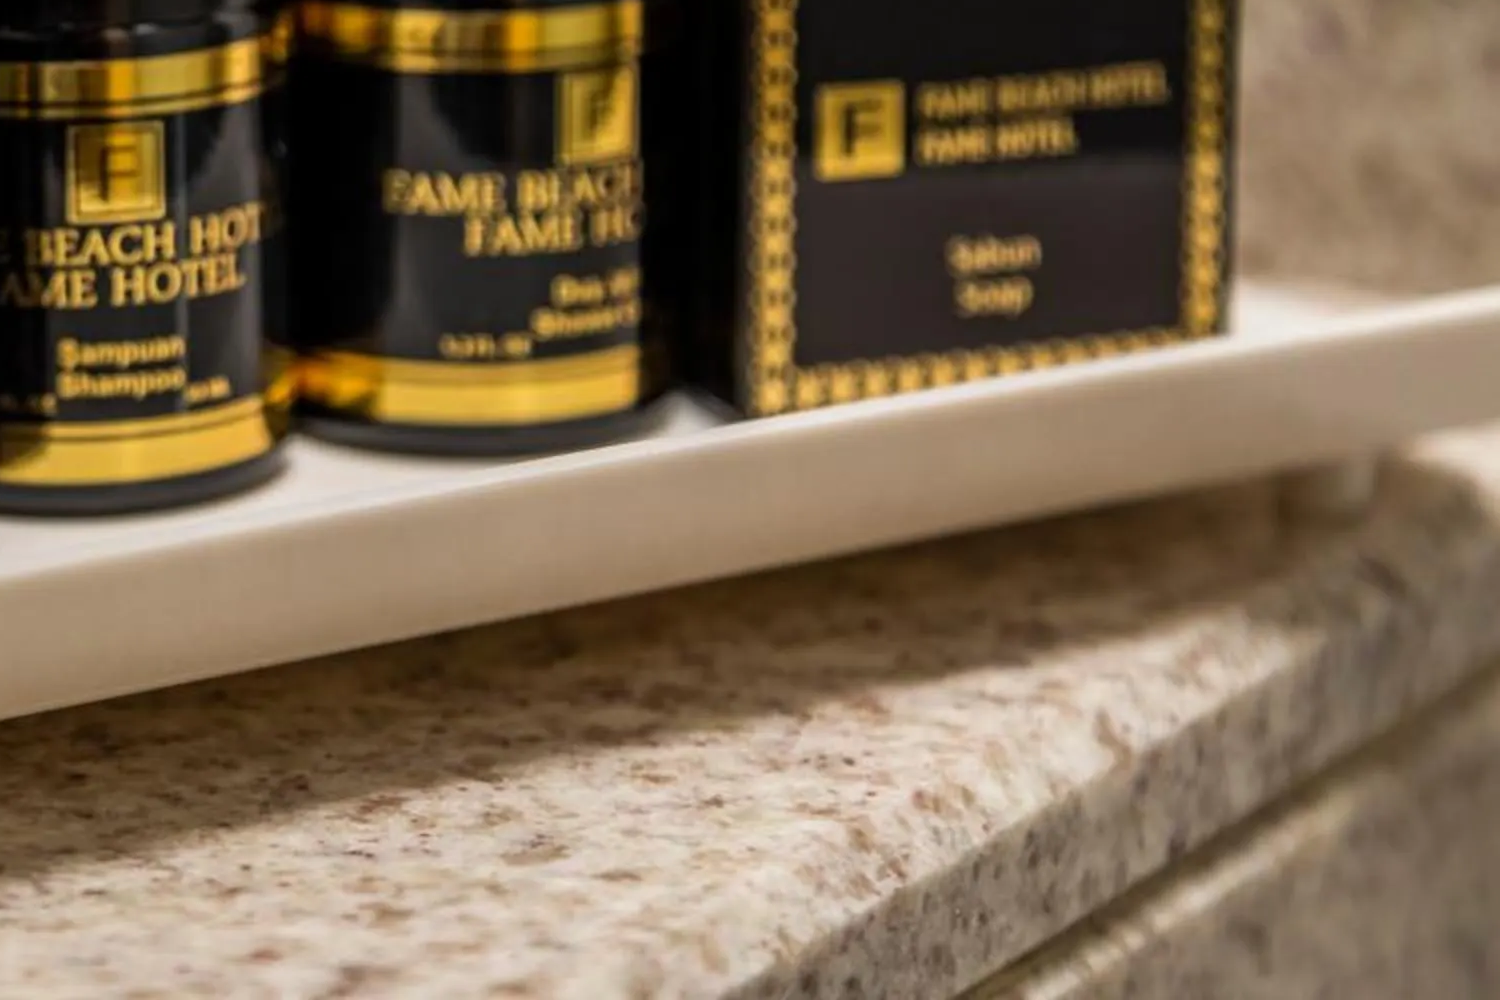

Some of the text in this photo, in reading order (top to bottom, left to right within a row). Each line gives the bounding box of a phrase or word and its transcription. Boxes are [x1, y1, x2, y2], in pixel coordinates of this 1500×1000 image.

[384, 169, 504, 214] FAME
[25, 221, 176, 266] BEACH
[188, 203, 264, 254] HOT
[464, 210, 581, 257] FAME
[2, 252, 246, 308] AME HOTEL
